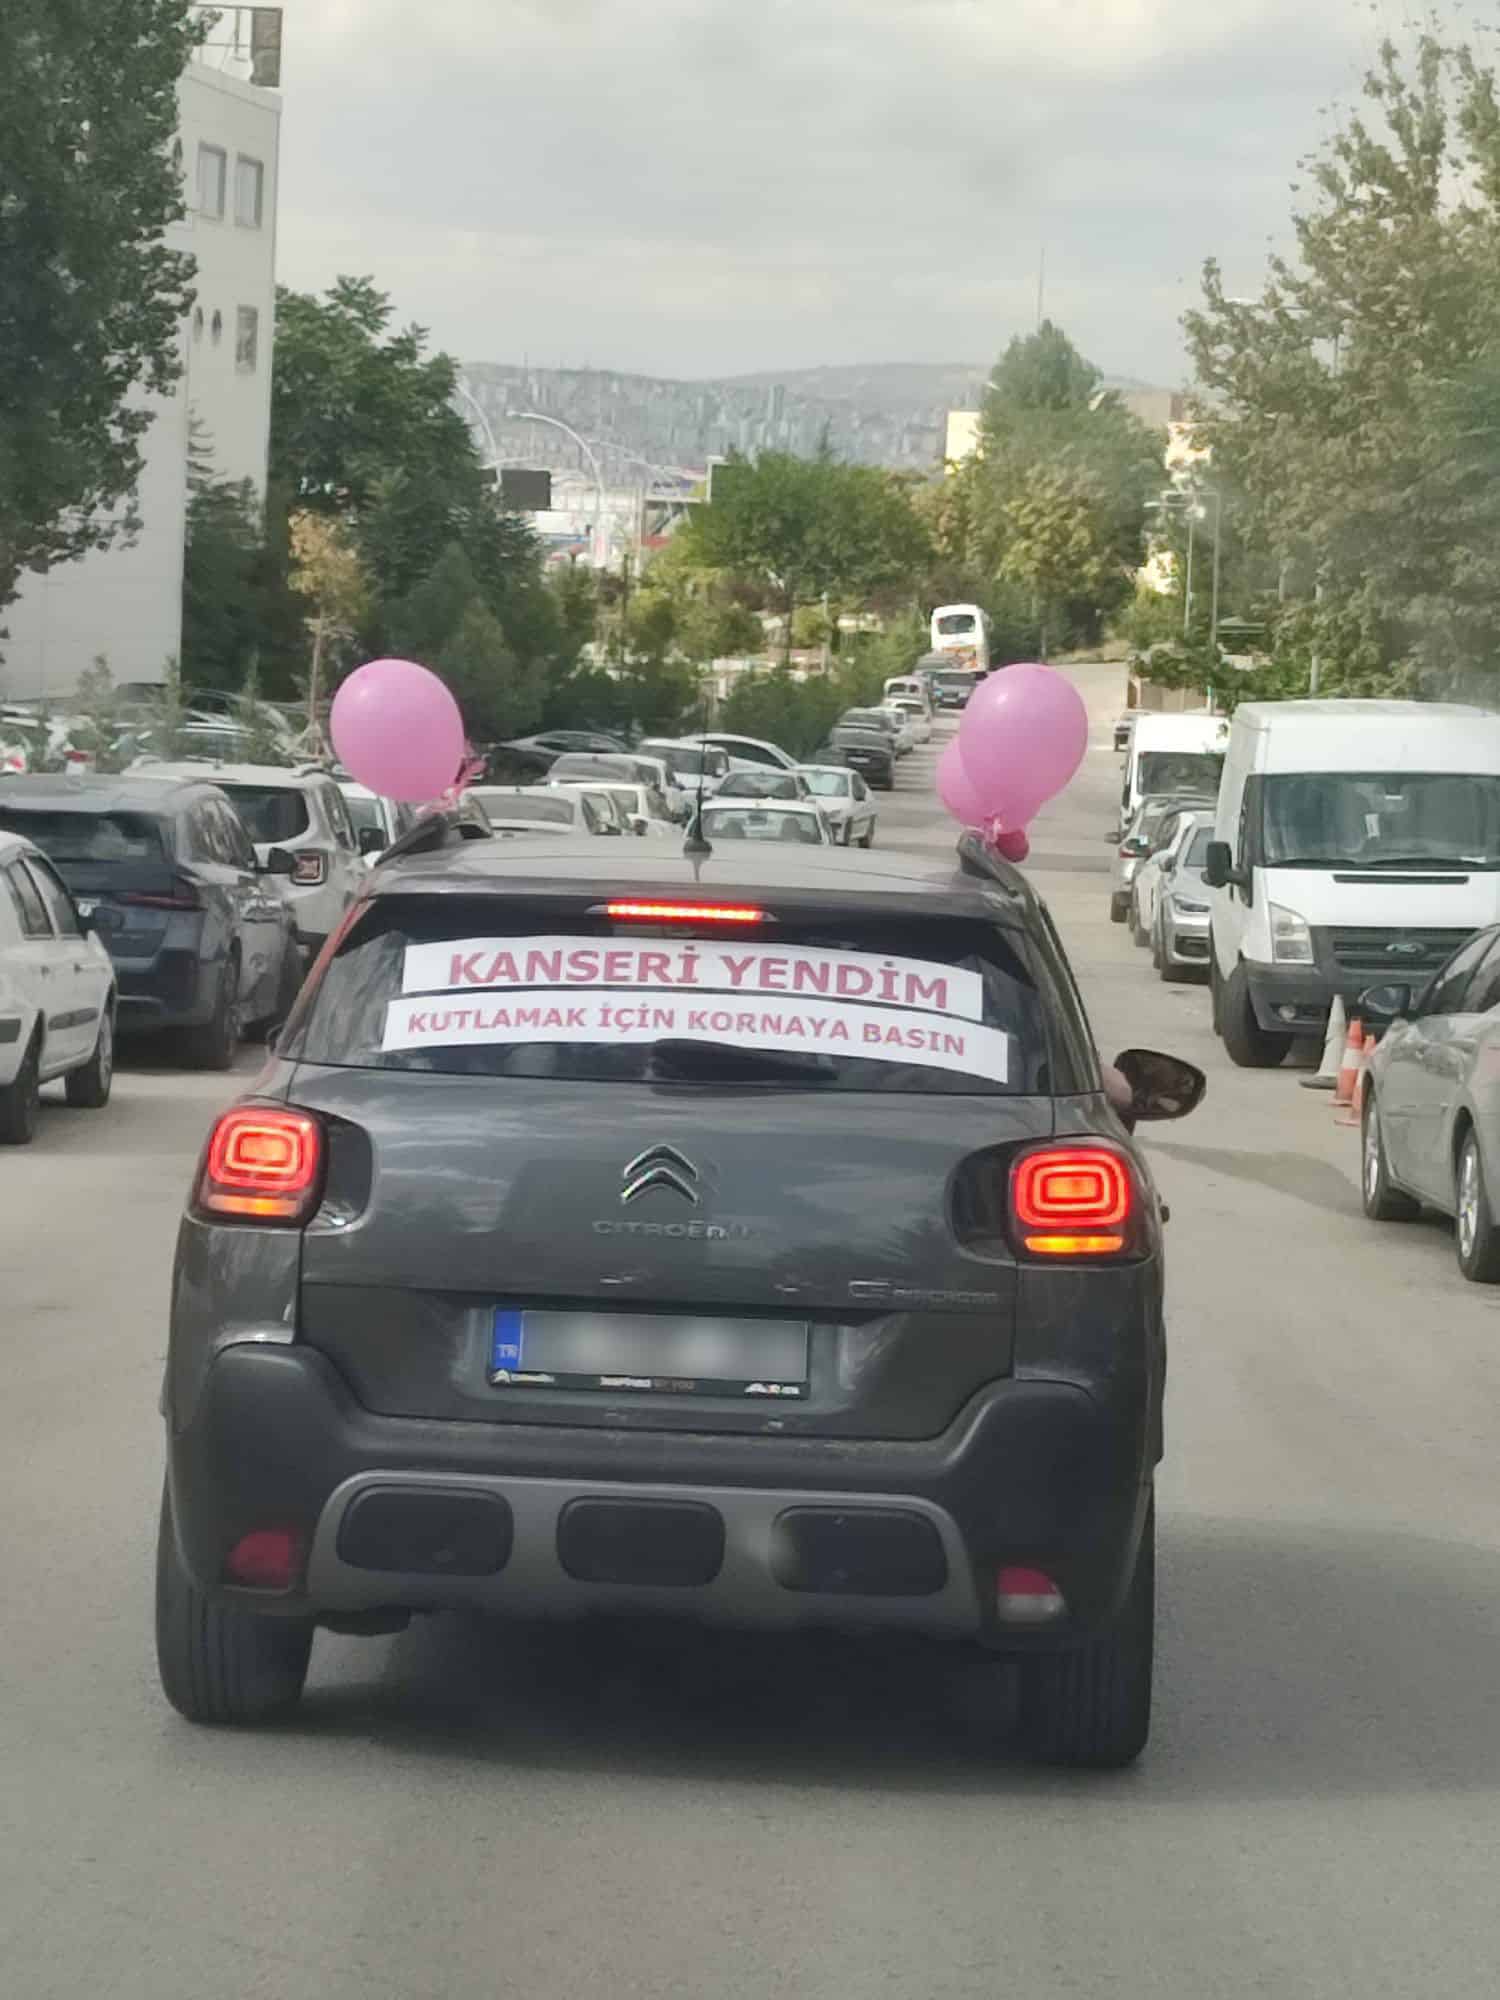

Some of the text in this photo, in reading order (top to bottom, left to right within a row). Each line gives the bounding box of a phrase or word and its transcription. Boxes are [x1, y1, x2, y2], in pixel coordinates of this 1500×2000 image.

[449, 945, 948, 1009] KANSERİ YENDİM
[408, 1001, 965, 1057] KUTLAMAK İÇİN KORNAYA BASIN
